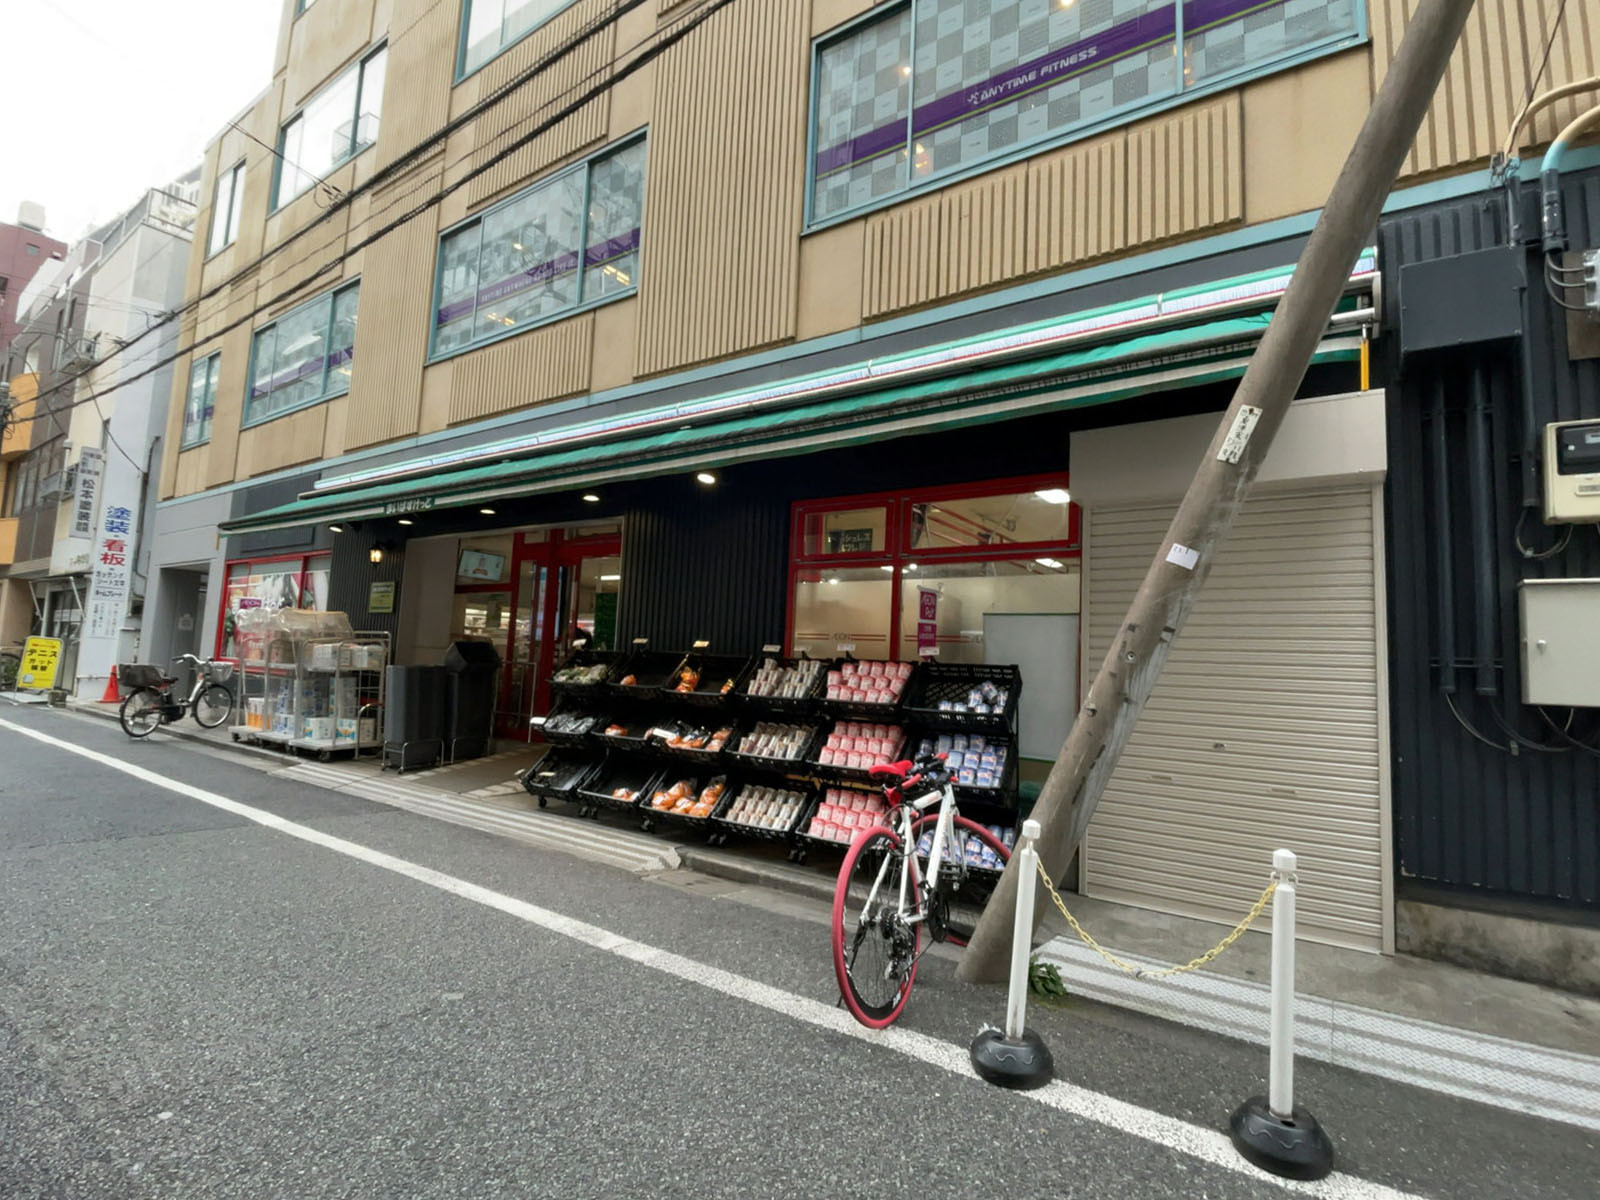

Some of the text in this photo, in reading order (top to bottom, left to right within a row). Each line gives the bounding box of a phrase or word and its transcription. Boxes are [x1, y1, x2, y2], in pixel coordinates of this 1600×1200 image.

[981, 46, 1098, 100] ANYTIME FITNESS
[27, 649, 58, 658] テニス
